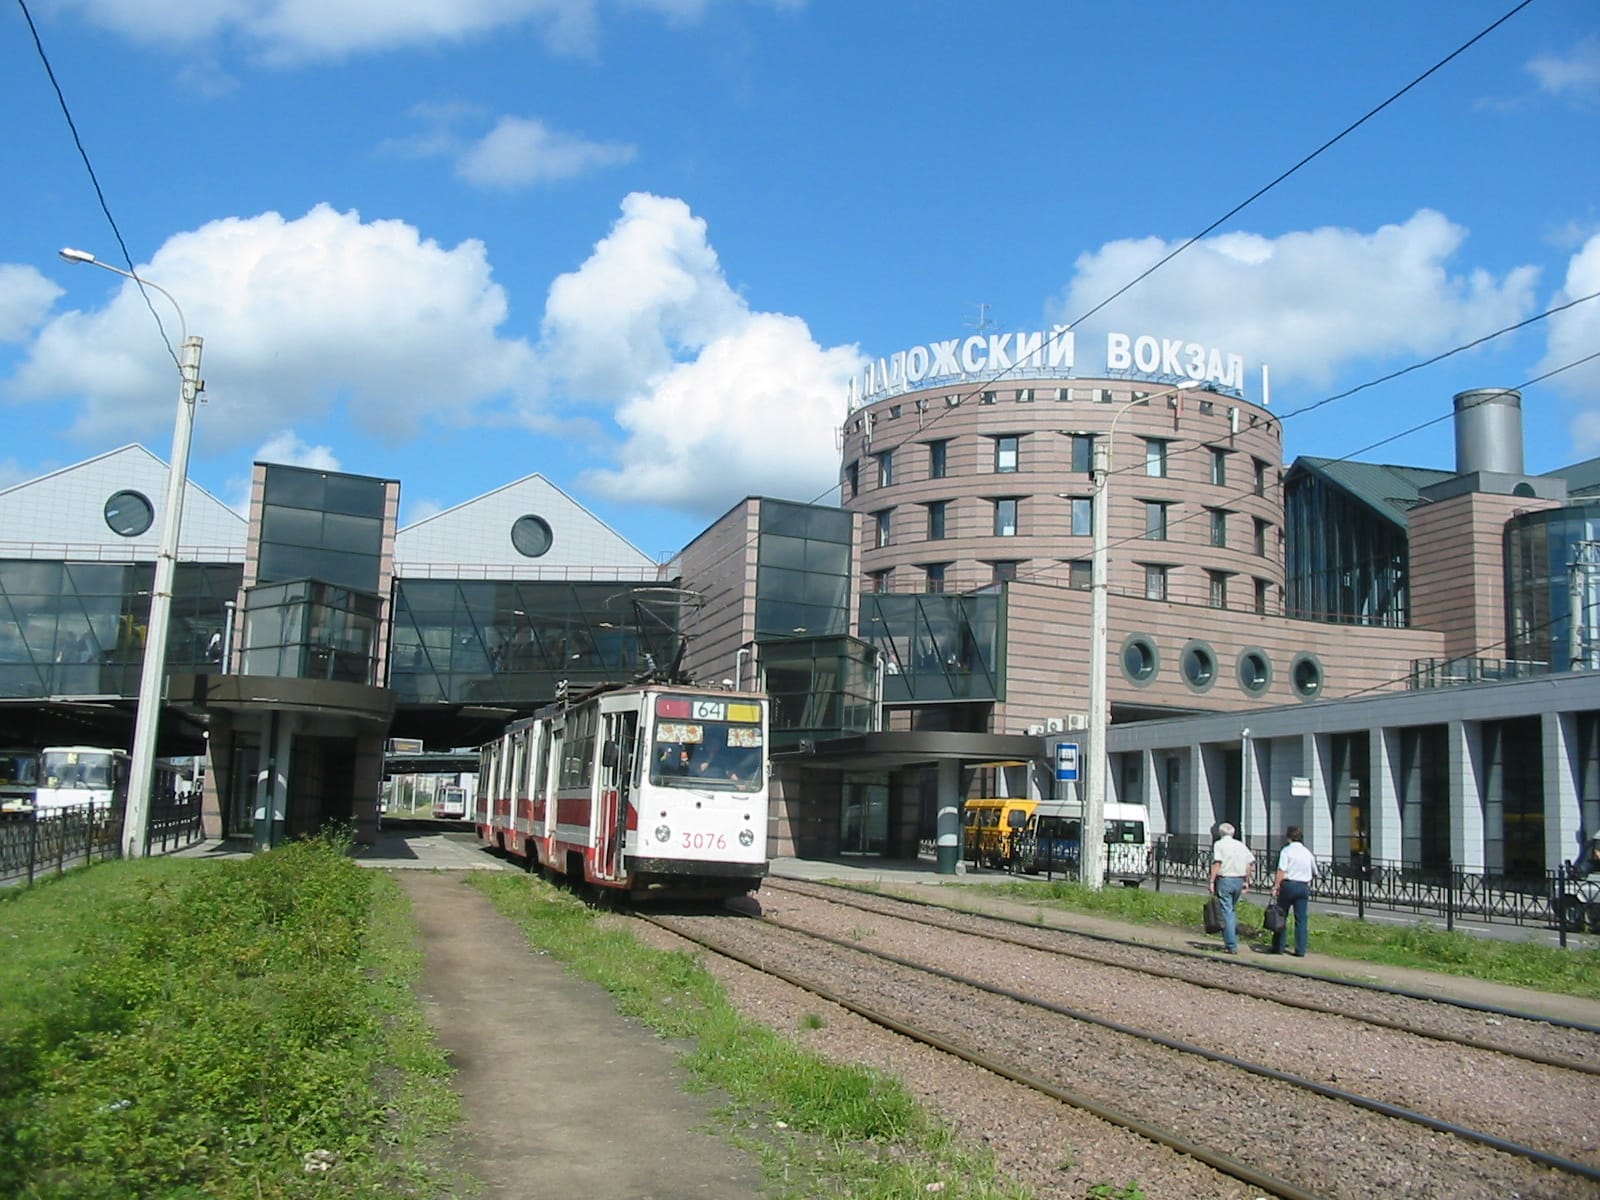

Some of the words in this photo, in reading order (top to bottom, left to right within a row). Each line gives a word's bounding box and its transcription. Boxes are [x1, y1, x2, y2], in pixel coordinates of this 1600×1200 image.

[863, 325, 1075, 396] ЛАДОЖСКИЙ
[1107, 332, 1243, 392] ВОКЗАЛ
[698, 701, 721, 718] 64
[682, 832, 726, 849] 3076
